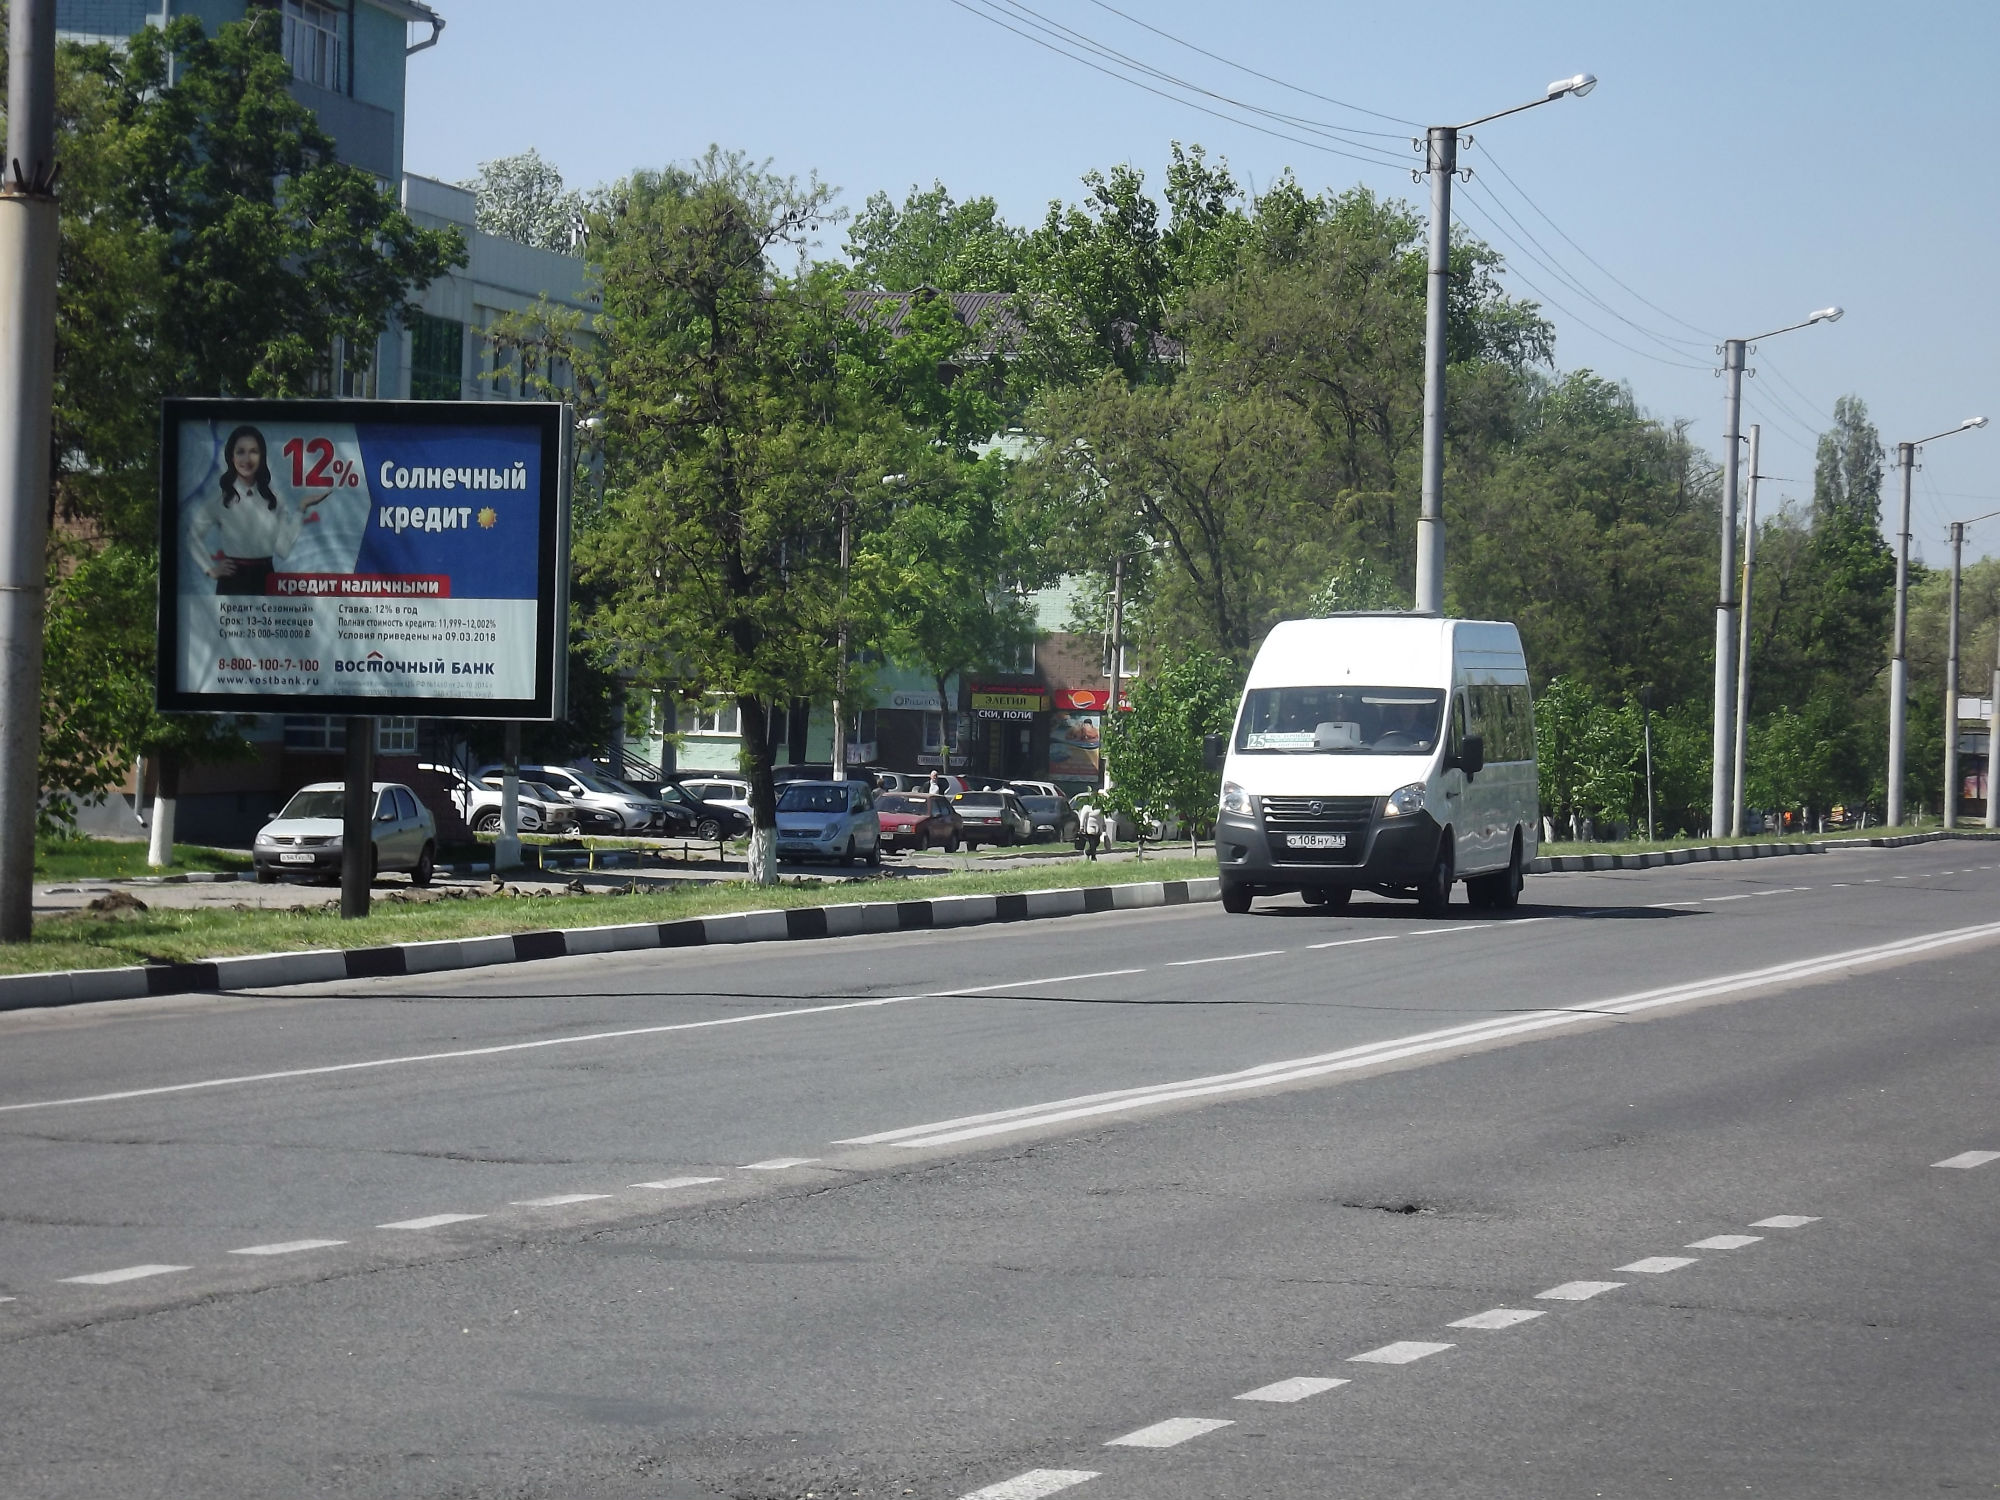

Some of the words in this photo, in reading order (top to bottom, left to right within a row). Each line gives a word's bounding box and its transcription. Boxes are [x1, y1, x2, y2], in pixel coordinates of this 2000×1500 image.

[283, 437, 358, 488] 12%
[379, 460, 527, 491] Солнечный
[379, 505, 472, 534] кредит
[277, 578, 338, 595] кредит
[341, 578, 440, 595] наличными
[219, 602, 253, 613] Кредит
[338, 604, 372, 614] Ставка:
[375, 605, 392, 614] 12%
[395, 606, 401, 614] в
[403, 606, 418, 616] год
[219, 615, 243, 627] Срок:
[274, 618, 314, 628] месяцев
[338, 617, 365, 627] Полная
[366, 618, 402, 628] стоимость
[404, 619, 437, 629] кредита:
[338, 631, 375, 641] Условия
[377, 632, 430, 642] приведены
[432, 633, 443, 641] на
[445, 631, 496, 642] 09.03.2018
[218, 658, 319, 672] 8-800-100-7-100
[451, 661, 496, 675] БАНК
[217, 675, 319, 686] www.vostbank.ru
[1003, 711, 1032, 720] ПОЛИ
[1250, 735, 1265, 747] 25
